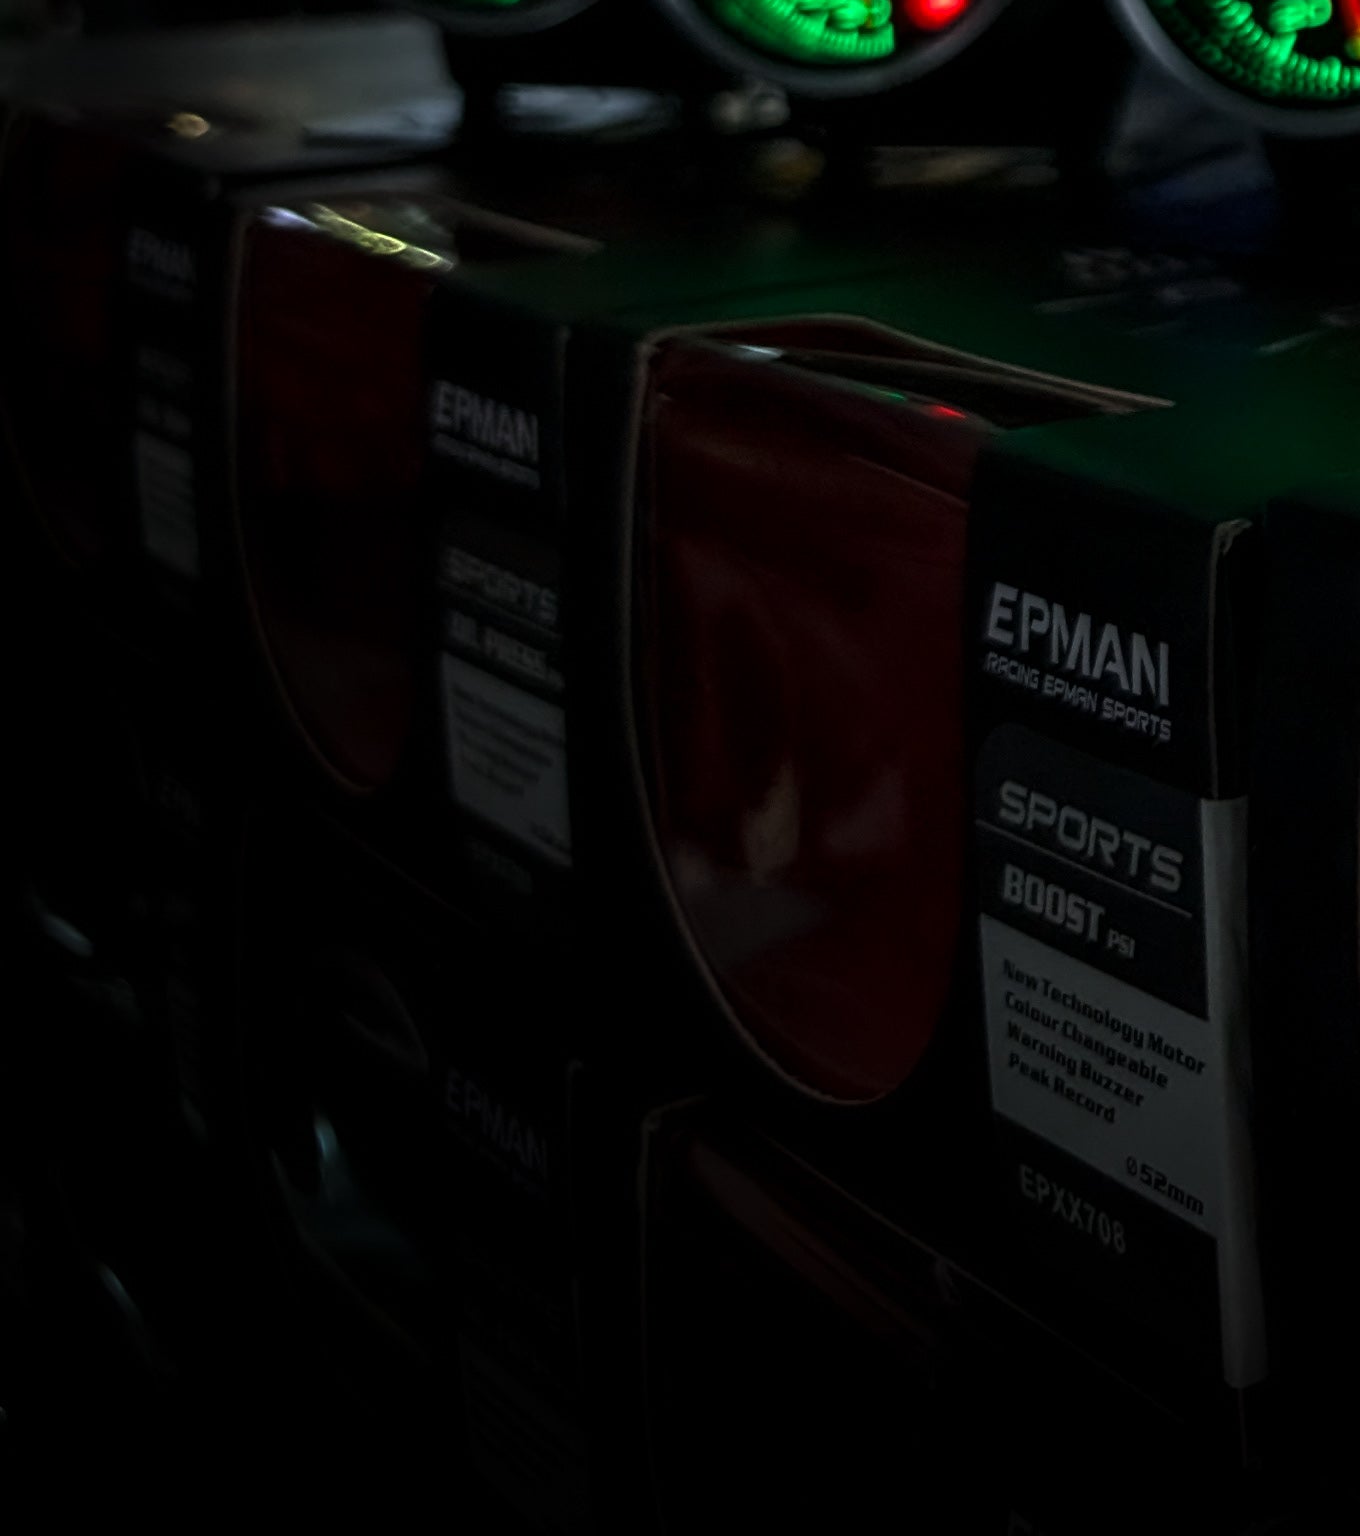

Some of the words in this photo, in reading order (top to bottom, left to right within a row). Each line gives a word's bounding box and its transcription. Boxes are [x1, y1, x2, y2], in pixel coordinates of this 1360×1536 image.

[431, 379, 540, 465] EPMAN
[981, 580, 1170, 710] EPMAN
[1100, 695, 1173, 743] SPORTS
[997, 779, 1184, 894] SPORTS
[1003, 863, 1106, 943] BOOST
[1003, 958, 1037, 991] New
[1041, 978, 1144, 1048] Technology
[1147, 1032, 1206, 1075] Motor
[1005, 991, 1060, 1031] Colour
[1061, 1018, 1169, 1089] Changeable
[1007, 1021, 1077, 1077] Warning
[1080, 1061, 1145, 1107] Buzzer
[1008, 1052, 1050, 1088] Peak
[1054, 1076, 1116, 1123] Record
